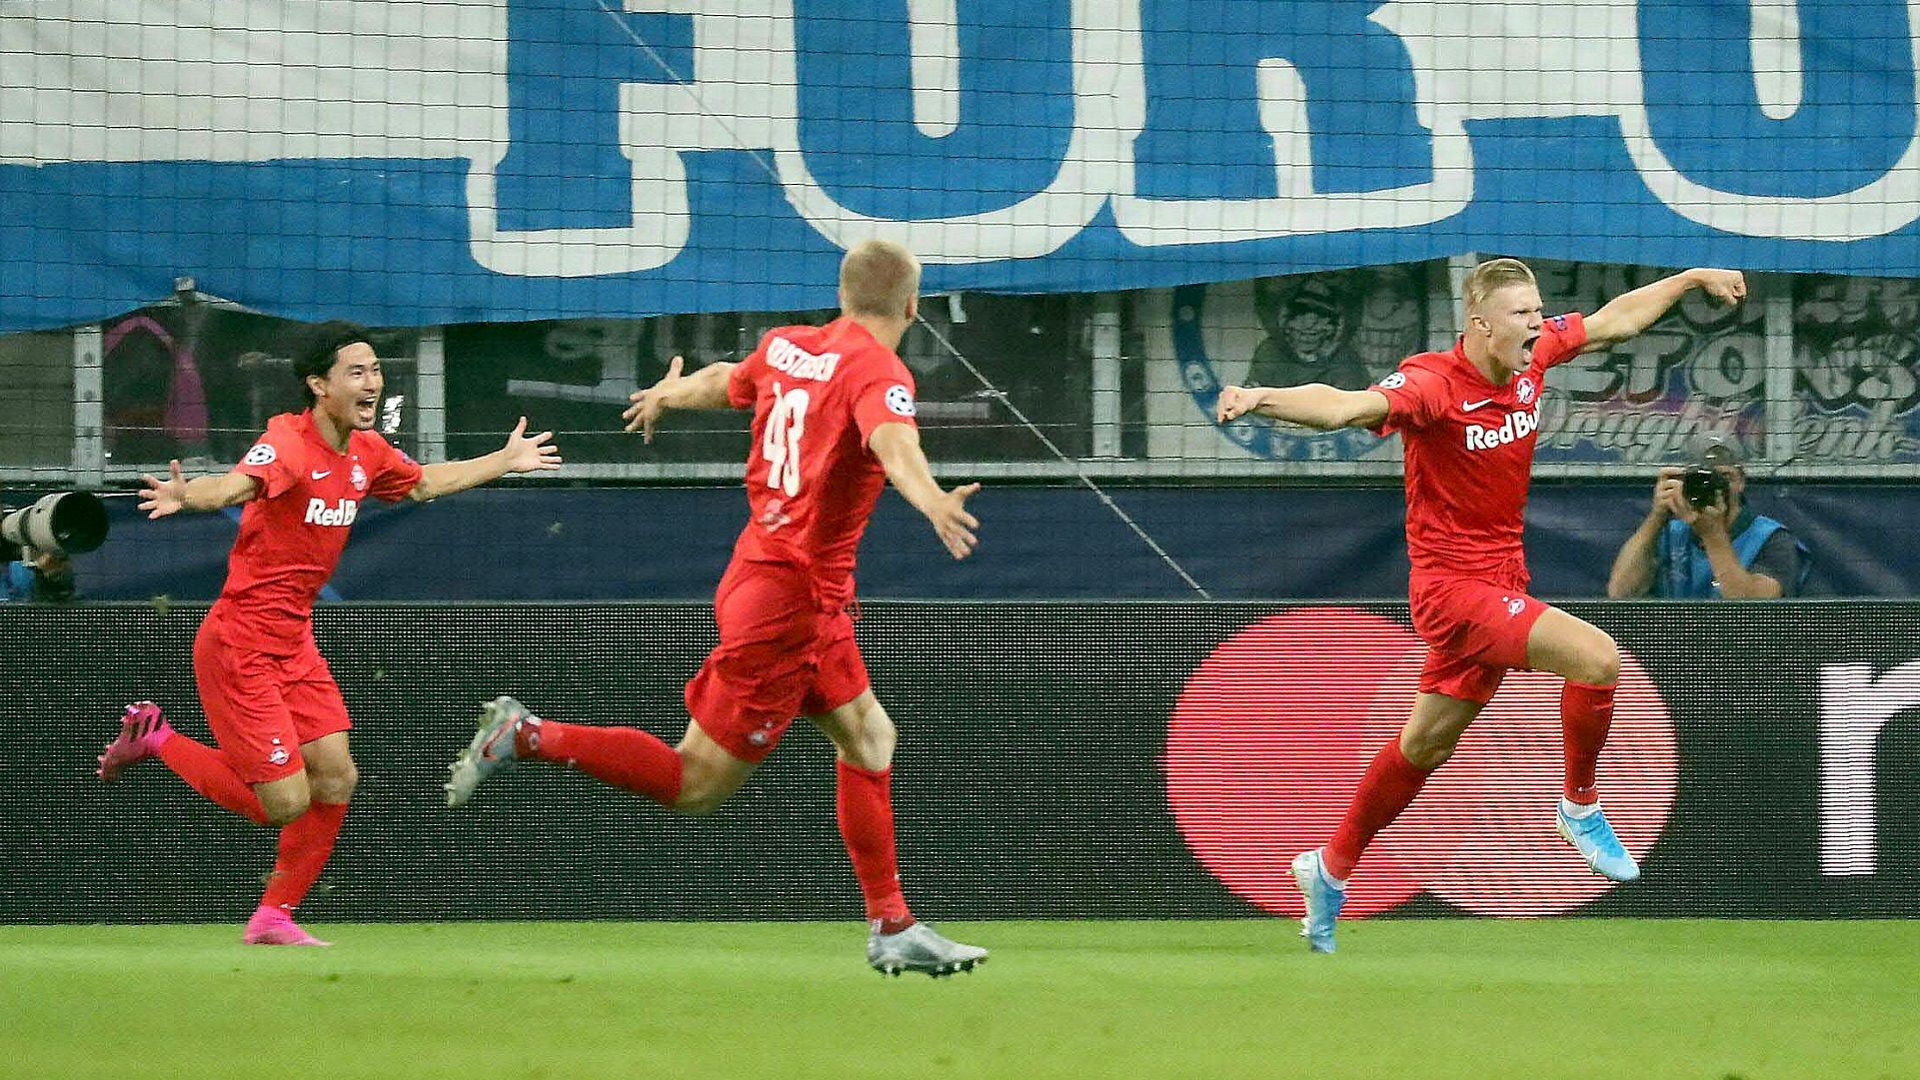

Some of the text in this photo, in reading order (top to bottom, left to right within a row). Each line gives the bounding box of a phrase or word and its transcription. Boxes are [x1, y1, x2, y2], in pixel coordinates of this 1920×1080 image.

[763, 381, 809, 497] 43
[1465, 414, 1513, 451] Red
[304, 498, 345, 526] Red
